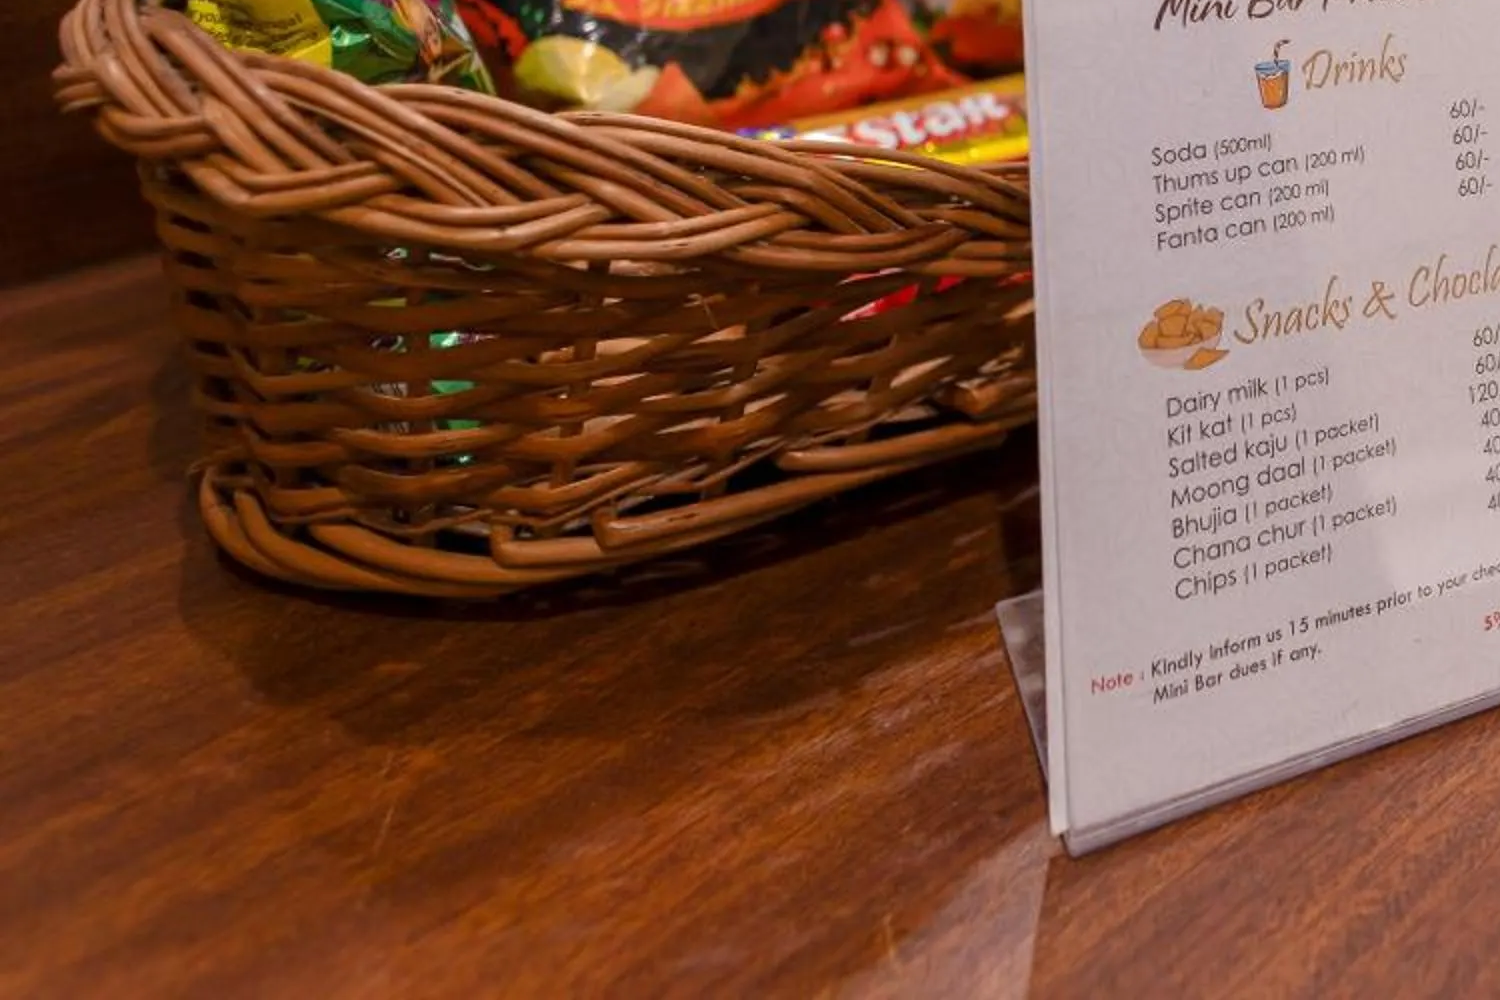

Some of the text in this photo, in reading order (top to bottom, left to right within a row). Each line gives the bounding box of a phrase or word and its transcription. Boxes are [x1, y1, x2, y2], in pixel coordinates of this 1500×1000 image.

[1301, 33, 1407, 90] Drinks
[852, 92, 1012, 150] Star
[1450, 97, 1486, 119] 60/-
[1453, 123, 1489, 145] 60/-
[1151, 132, 1272, 167] Soda (500ml)
[1152, 169, 1219, 195] Thums
[1224, 164, 1251, 185] up
[1257, 156, 1299, 178] can
[1304, 148, 1337, 173] (200
[1455, 148, 1490, 171] 60/-
[1154, 198, 1213, 225] Sprite
[1219, 190, 1261, 212] can
[1268, 183, 1301, 207] (200
[1458, 174, 1493, 197] 60/-
[1156, 226, 1219, 251] Fanta
[1224, 217, 1267, 239] can
[1273, 209, 1306, 233] (200
[1233, 275, 1351, 346] Snacks
[1363, 280, 1398, 320] &
[1165, 391, 1222, 419] Dairy
[1227, 377, 1269, 404] milk
[1294, 367, 1330, 393] pcs)
[1166, 424, 1193, 449] Kit
[1199, 416, 1233, 441] kat
[1260, 402, 1298, 429] pcs)
[1168, 443, 1238, 479] Salted
[1244, 433, 1288, 461] kaju
[1314, 412, 1380, 445] packet)
[1170, 473, 1250, 509] Moong
[1256, 456, 1306, 487] daal
[1332, 436, 1398, 472] packet)
[1171, 506, 1238, 539] Bhujia
[1265, 483, 1334, 518] packet)
[1172, 534, 1251, 570] Chana
[1257, 517, 1308, 548] chur
[1332, 495, 1398, 531] packet)
[1174, 568, 1238, 600] Chips
[1264, 542, 1334, 579] packet)
[1090, 670, 1134, 694] Note
[1150, 650, 1203, 679] Kindly
[1265, 629, 1284, 645] us
[1288, 616, 1310, 637] 15
[1314, 603, 1373, 629] minutes
[1376, 589, 1413, 616] prior
[1416, 585, 1433, 599] to
[1436, 572, 1468, 597] your
[1153, 642, 1323, 705] Mini Bar dues if any.
